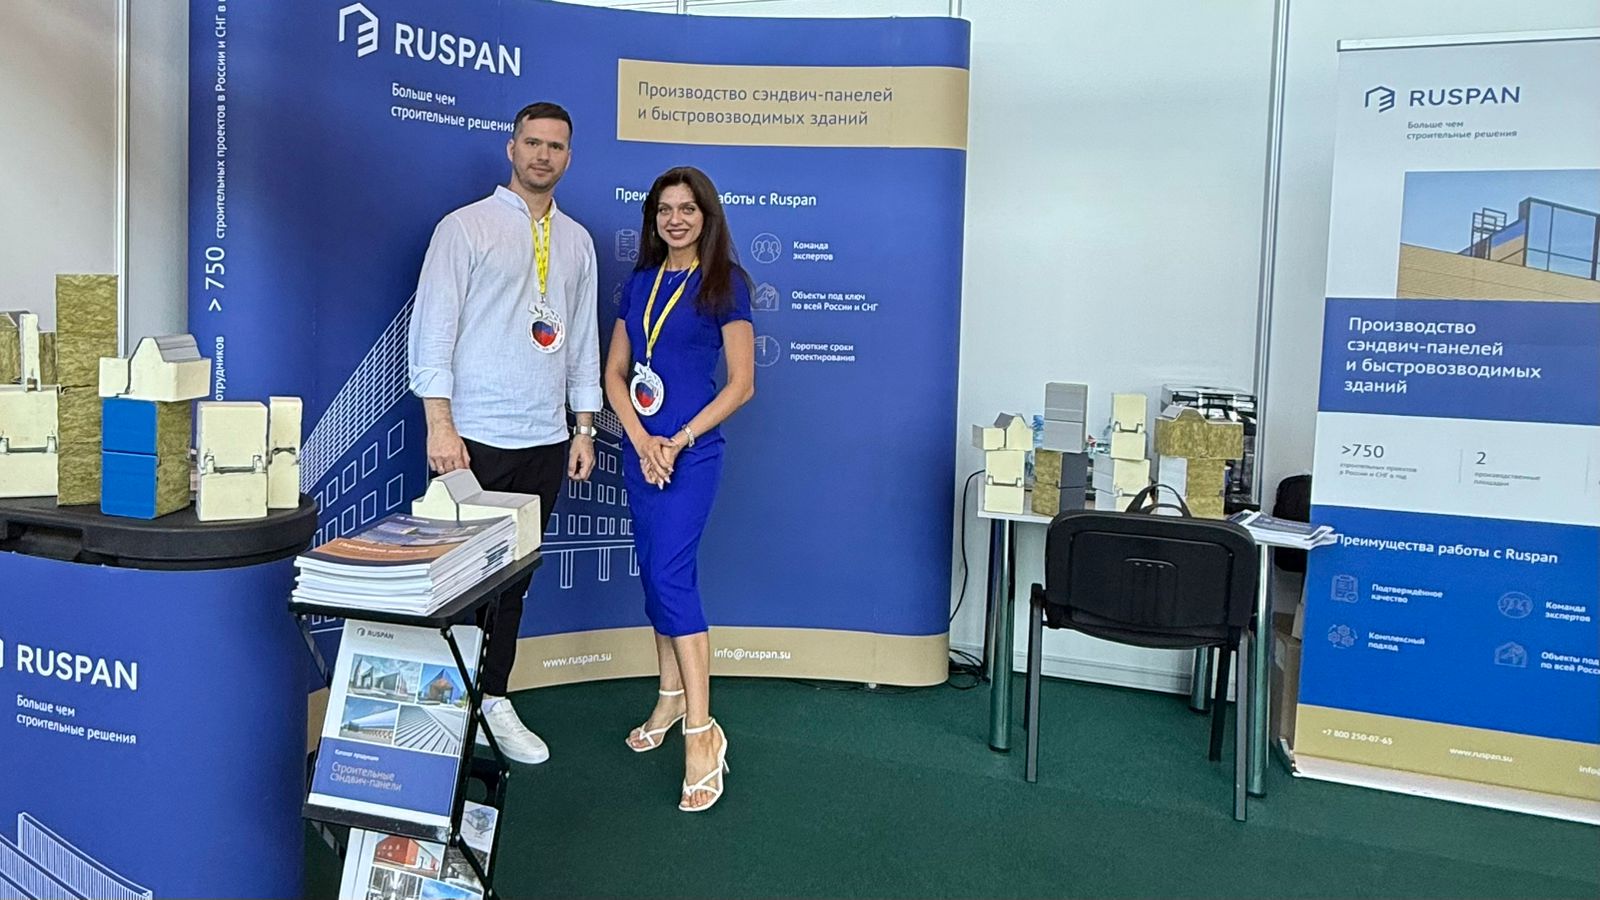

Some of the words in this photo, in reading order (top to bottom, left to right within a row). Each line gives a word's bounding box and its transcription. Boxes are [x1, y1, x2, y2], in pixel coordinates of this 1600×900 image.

[215, 14, 226, 38] СНГ
[394, 22, 521, 77] RUSPAN
[215, 51, 226, 92] России
[391, 83, 433, 102] Больше
[435, 93, 456, 106] чем
[638, 81, 748, 102] Производство
[752, 88, 893, 104] сэндвич-панелей
[1408, 86, 1521, 107] RUSPAN
[390, 106, 465, 127] строительные
[638, 109, 647, 120] и
[652, 107, 805, 126] быстровозводимых
[809, 111, 869, 127] зданий
[1407, 121, 1443, 129] Больше
[217, 105, 228, 157] проектов
[1406, 132, 1472, 141] строительные
[1473, 130, 1518, 140] решения
[216, 160, 228, 239] строительных
[717, 191, 755, 205] аботы
[758, 195, 766, 205] с
[769, 192, 817, 208] Ruspan
[793, 240, 829, 251] Команда
[792, 252, 834, 262] экспертов
[205, 246, 225, 290] 750
[791, 290, 826, 300] Объекты
[827, 292, 844, 301] под
[845, 293, 866, 301] ключ
[791, 302, 802, 310] по
[803, 302, 822, 310] всей
[823, 302, 853, 311] России
[861, 302, 879, 312] СНГ
[1348, 317, 1477, 335] Производство
[790, 341, 829, 352] Короткие
[829, 343, 854, 352] сроки
[1346, 339, 1504, 356] сэндвич-панелей
[789, 353, 856, 363] проектирования
[216, 336, 226, 402] отрудников
[1345, 360, 1357, 372] и
[1361, 358, 1542, 379] быстровозводимых
[1343, 380, 1408, 394] зданий
[1341, 443, 1385, 459] >750
[1475, 451, 1487, 465] 2
[1335, 533, 1435, 553] Преимущества
[1438, 543, 1490, 559] работы
[1493, 550, 1502, 559] с
[1505, 548, 1559, 565] Ruspan
[1371, 594, 1409, 604] качество
[1545, 601, 1586, 613] Команда
[1544, 612, 1591, 622] экспертов
[1368, 631, 1426, 645] Комплексный
[1367, 642, 1399, 652] подход
[542, 651, 612, 668] www.ruspan.su
[713, 647, 792, 661] info@ruspan.su
[1541, 651, 1580, 663] Объекты
[1582, 657, 1600, 667] под
[16, 643, 139, 692] RUSPAN
[1553, 664, 1576, 672] всей
[16, 694, 54, 713] Больше
[55, 704, 76, 718] чем
[16, 713, 85, 737] строительные
[87, 728, 137, 745] решения
[1449, 747, 1513, 763] www.ruspan.su
[331, 761, 396, 782] Строительные
[329, 772, 402, 793] сэндвич-панели
